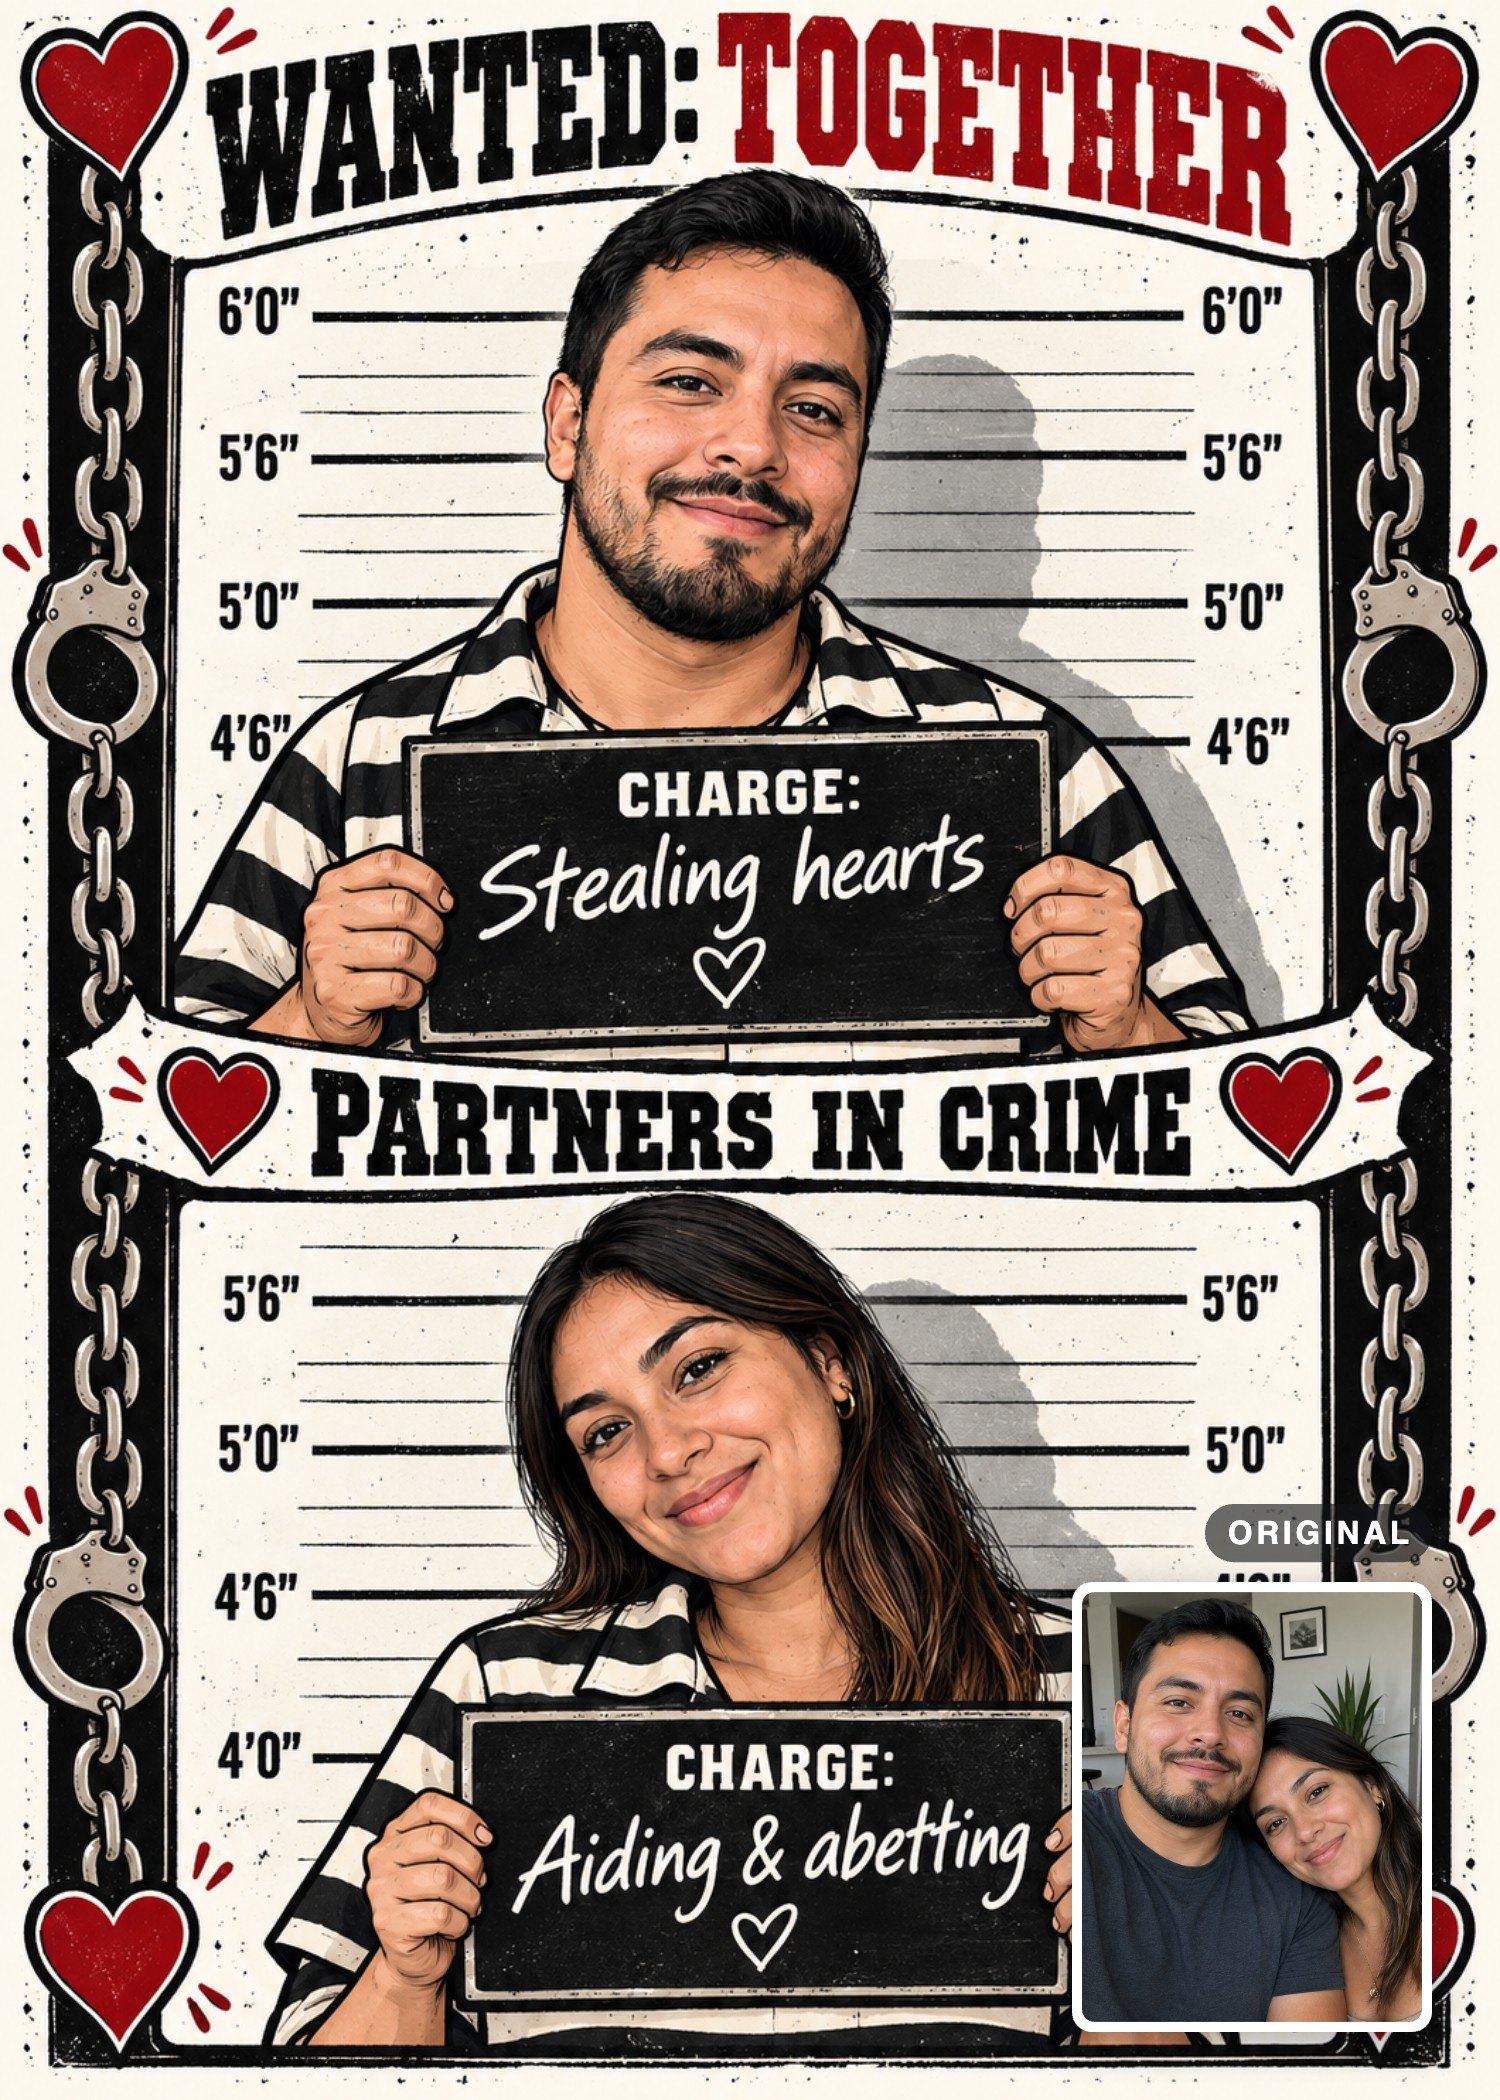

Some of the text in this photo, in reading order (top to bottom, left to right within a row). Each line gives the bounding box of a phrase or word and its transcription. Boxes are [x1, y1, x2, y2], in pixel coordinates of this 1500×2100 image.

[207, 12, 1291, 246] WANTED: TOGETHER
[619, 769, 859, 817] CHARGE:
[479, 814, 984, 939] Stealing hearts
[312, 1068, 1190, 1176] PARTNERS IN CRIME
[667, 1745, 893, 1790] CHARGE:
[512, 1799, 1030, 1923] Aiding & abetting
